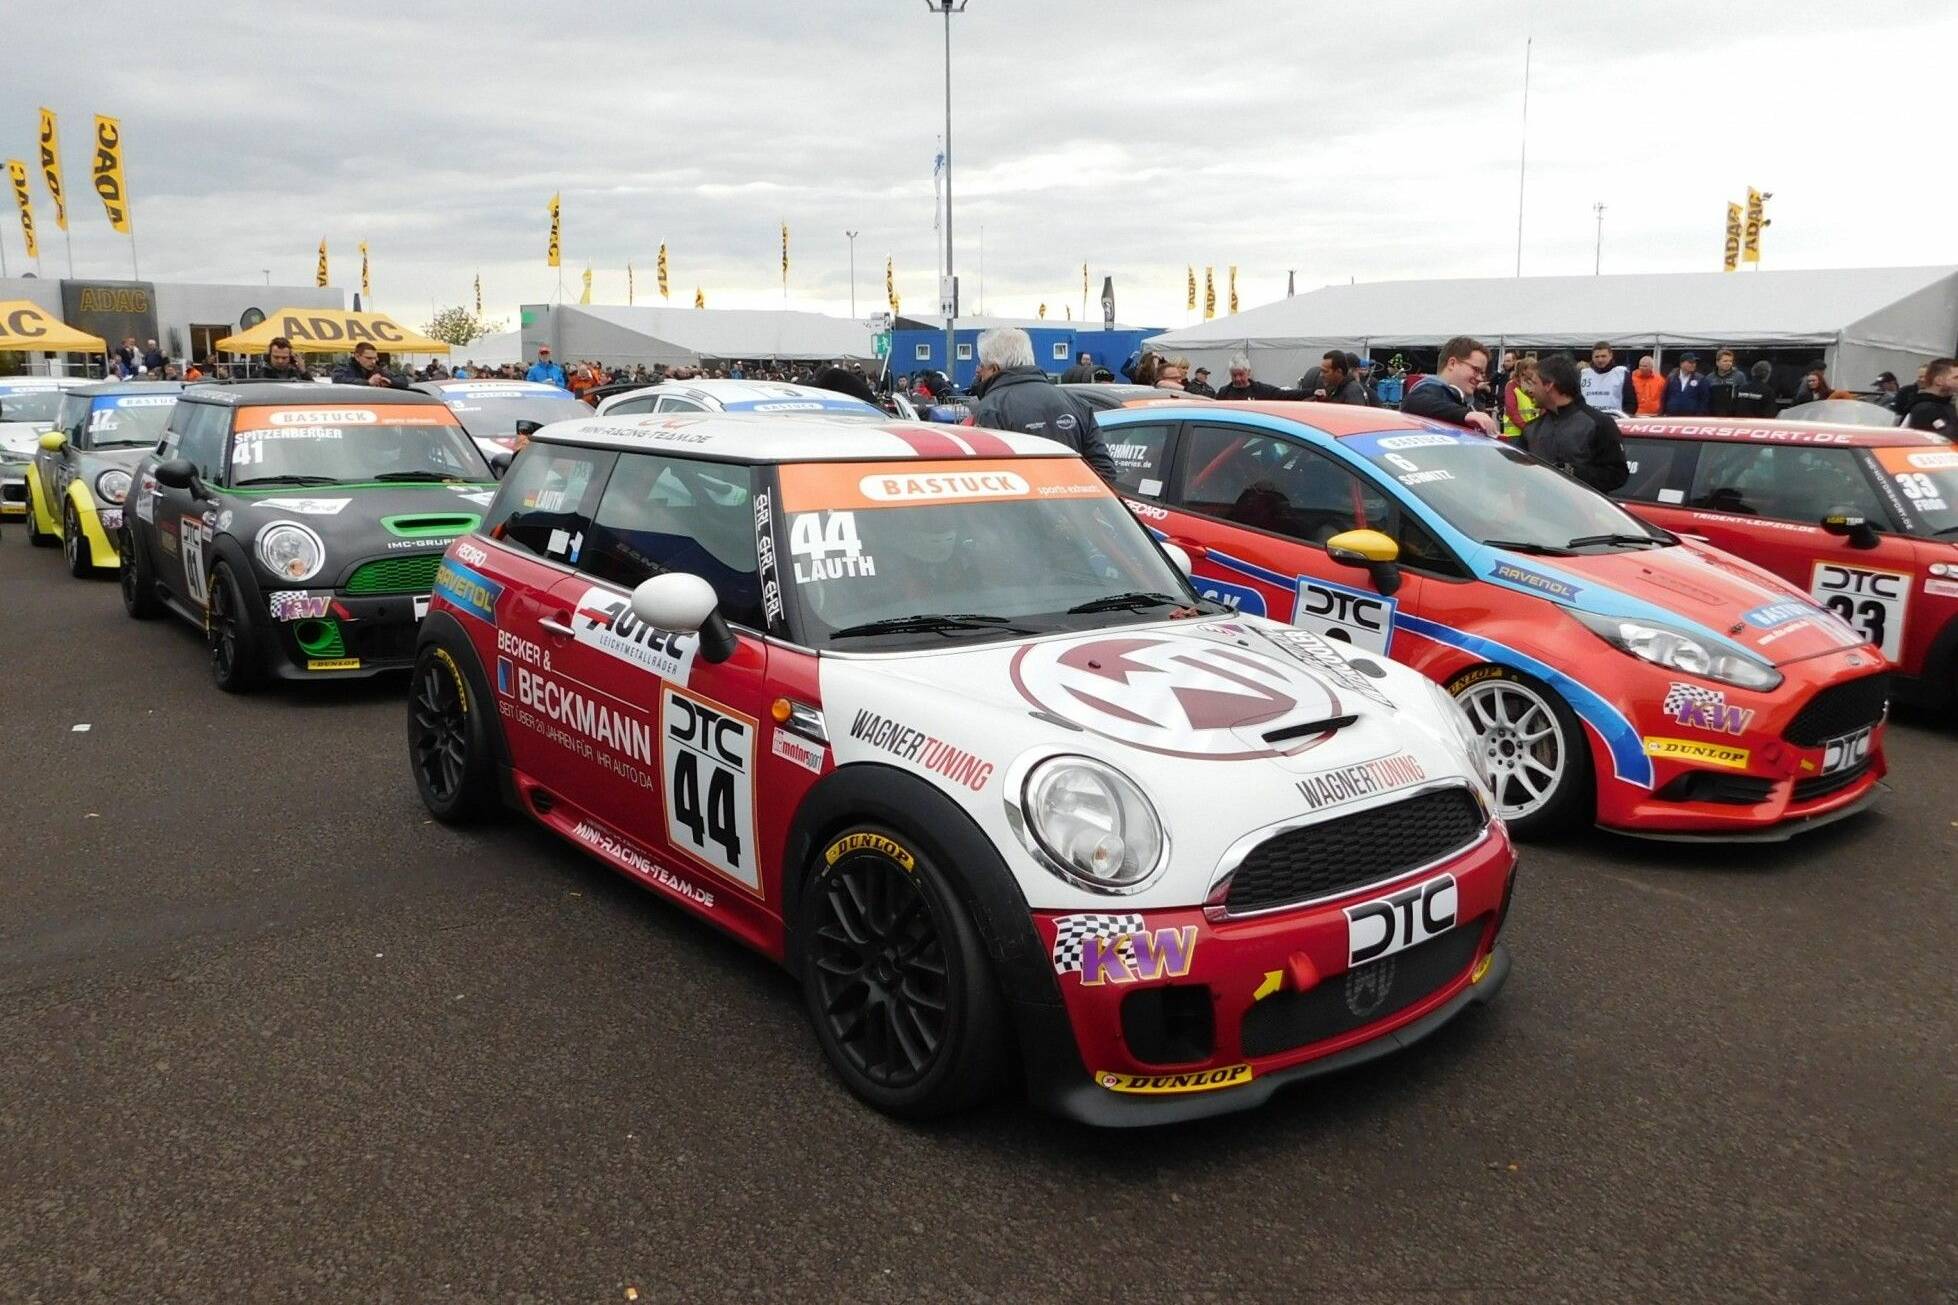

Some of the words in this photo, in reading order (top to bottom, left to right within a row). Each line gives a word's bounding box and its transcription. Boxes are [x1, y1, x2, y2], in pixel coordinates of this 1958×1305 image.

[80, 287, 147, 312] ADAC
[0, 309, 47, 337] C
[283, 316, 403, 341] ADAC
[283, 412, 367, 424] BASTUCK
[234, 426, 343, 445] SPITZENBERGER
[232, 440, 264, 465] 41
[882, 474, 1016, 496] BASTUCK
[1895, 473, 1939, 498] 33
[791, 512, 862, 560] 44
[794, 556, 875, 584] LAUTH
[1821, 565, 1900, 598] DTC
[279, 597, 330, 622] KW
[1304, 584, 1383, 631] DTC
[578, 602, 684, 660] AUTEC
[497, 629, 541, 667] BECKER
[543, 650, 551, 672] &
[518, 668, 651, 766] BECKMANN
[670, 693, 744, 768] DTC
[1678, 697, 1754, 735] KW
[850, 707, 993, 792] WAGNERTUNING
[1664, 742, 1745, 762] DUNLOP
[1296, 754, 1425, 809] WAGNERTUNING
[674, 749, 741, 869] 44
[838, 832, 911, 863] DUNLOP
[572, 822, 715, 907] MINI-RACING-TEAM.DE
[1347, 878, 1457, 962] DTC
[1081, 926, 1198, 985] KW
[1128, 1068, 1246, 1090] DUNLOP
